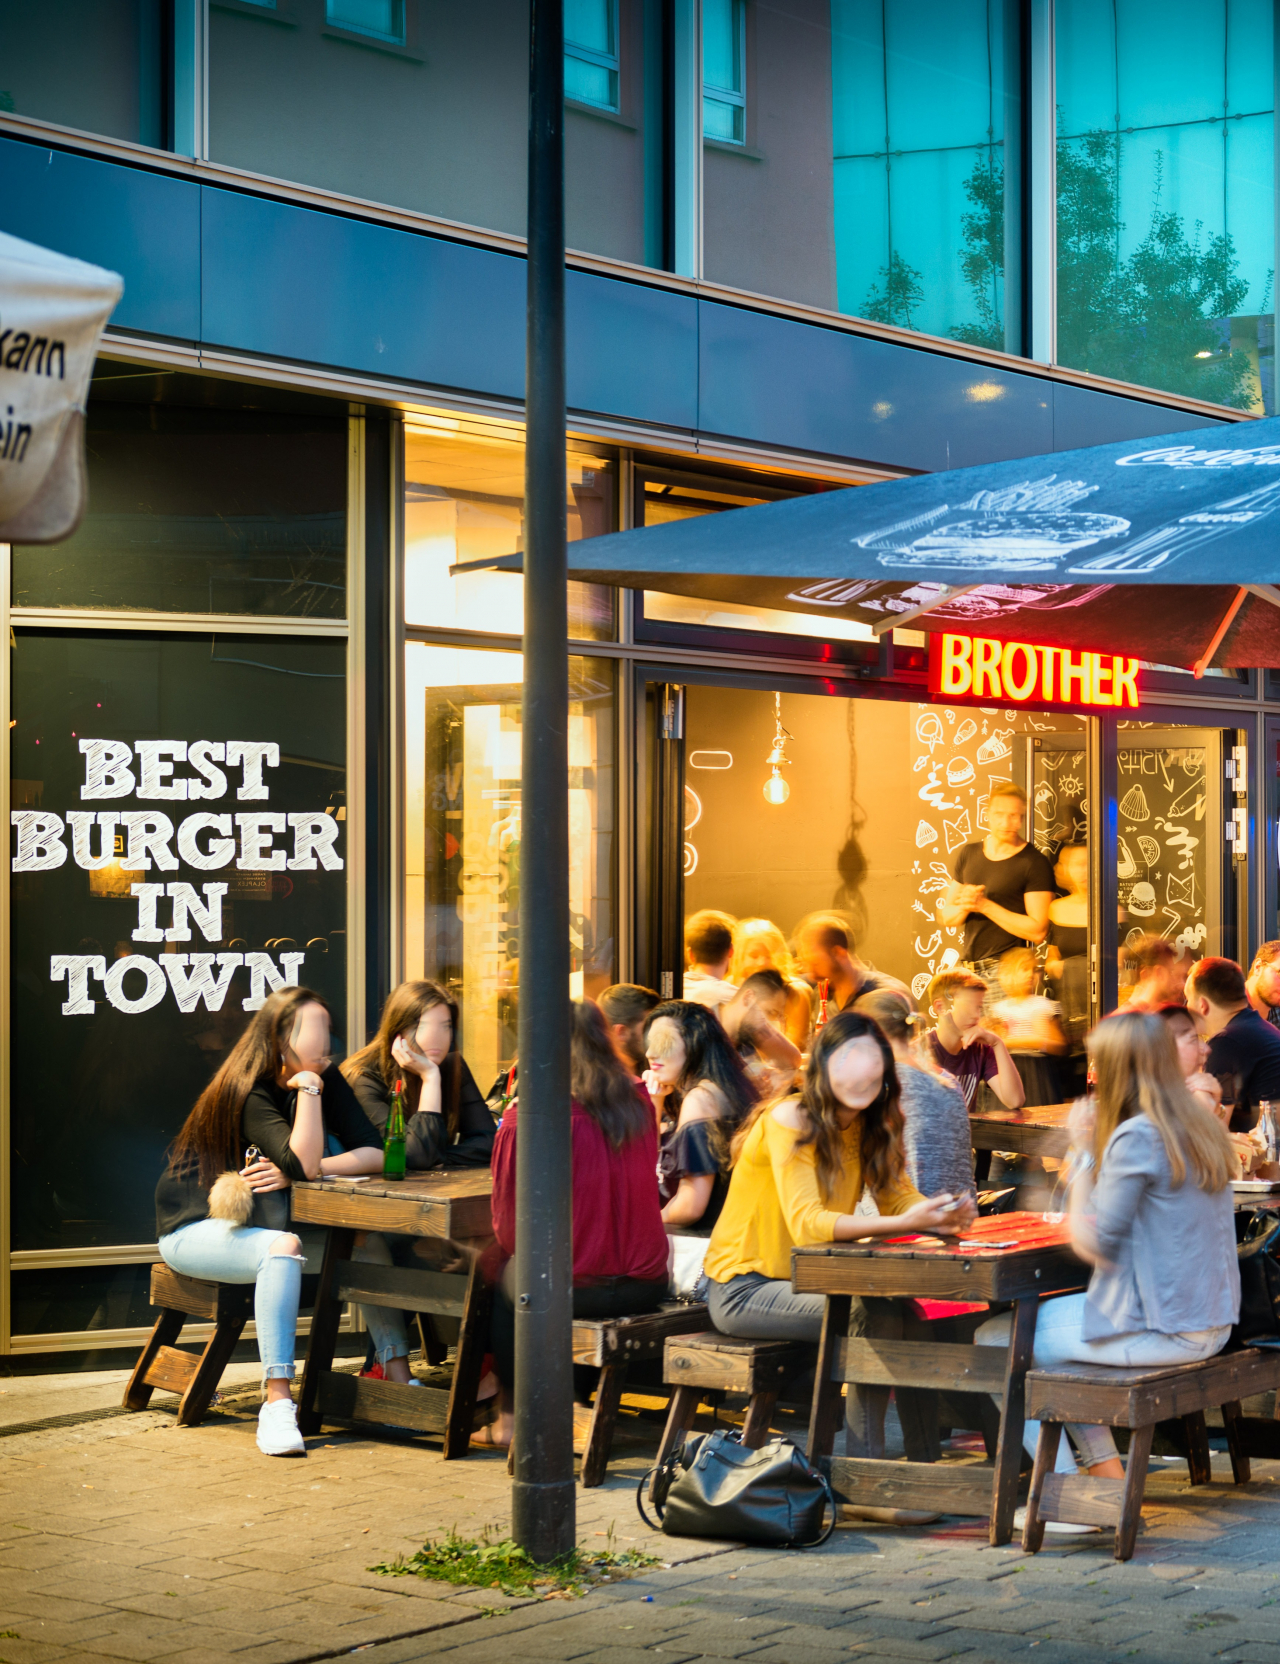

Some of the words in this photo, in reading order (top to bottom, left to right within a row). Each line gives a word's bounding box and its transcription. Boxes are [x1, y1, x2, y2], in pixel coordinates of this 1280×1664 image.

[940, 633, 1140, 708] BROTHER
[78, 739, 280, 801] BEST
[11, 810, 344, 873] BURGER
[131, 882, 228, 942] IN
[50, 952, 305, 1015] TOWN
